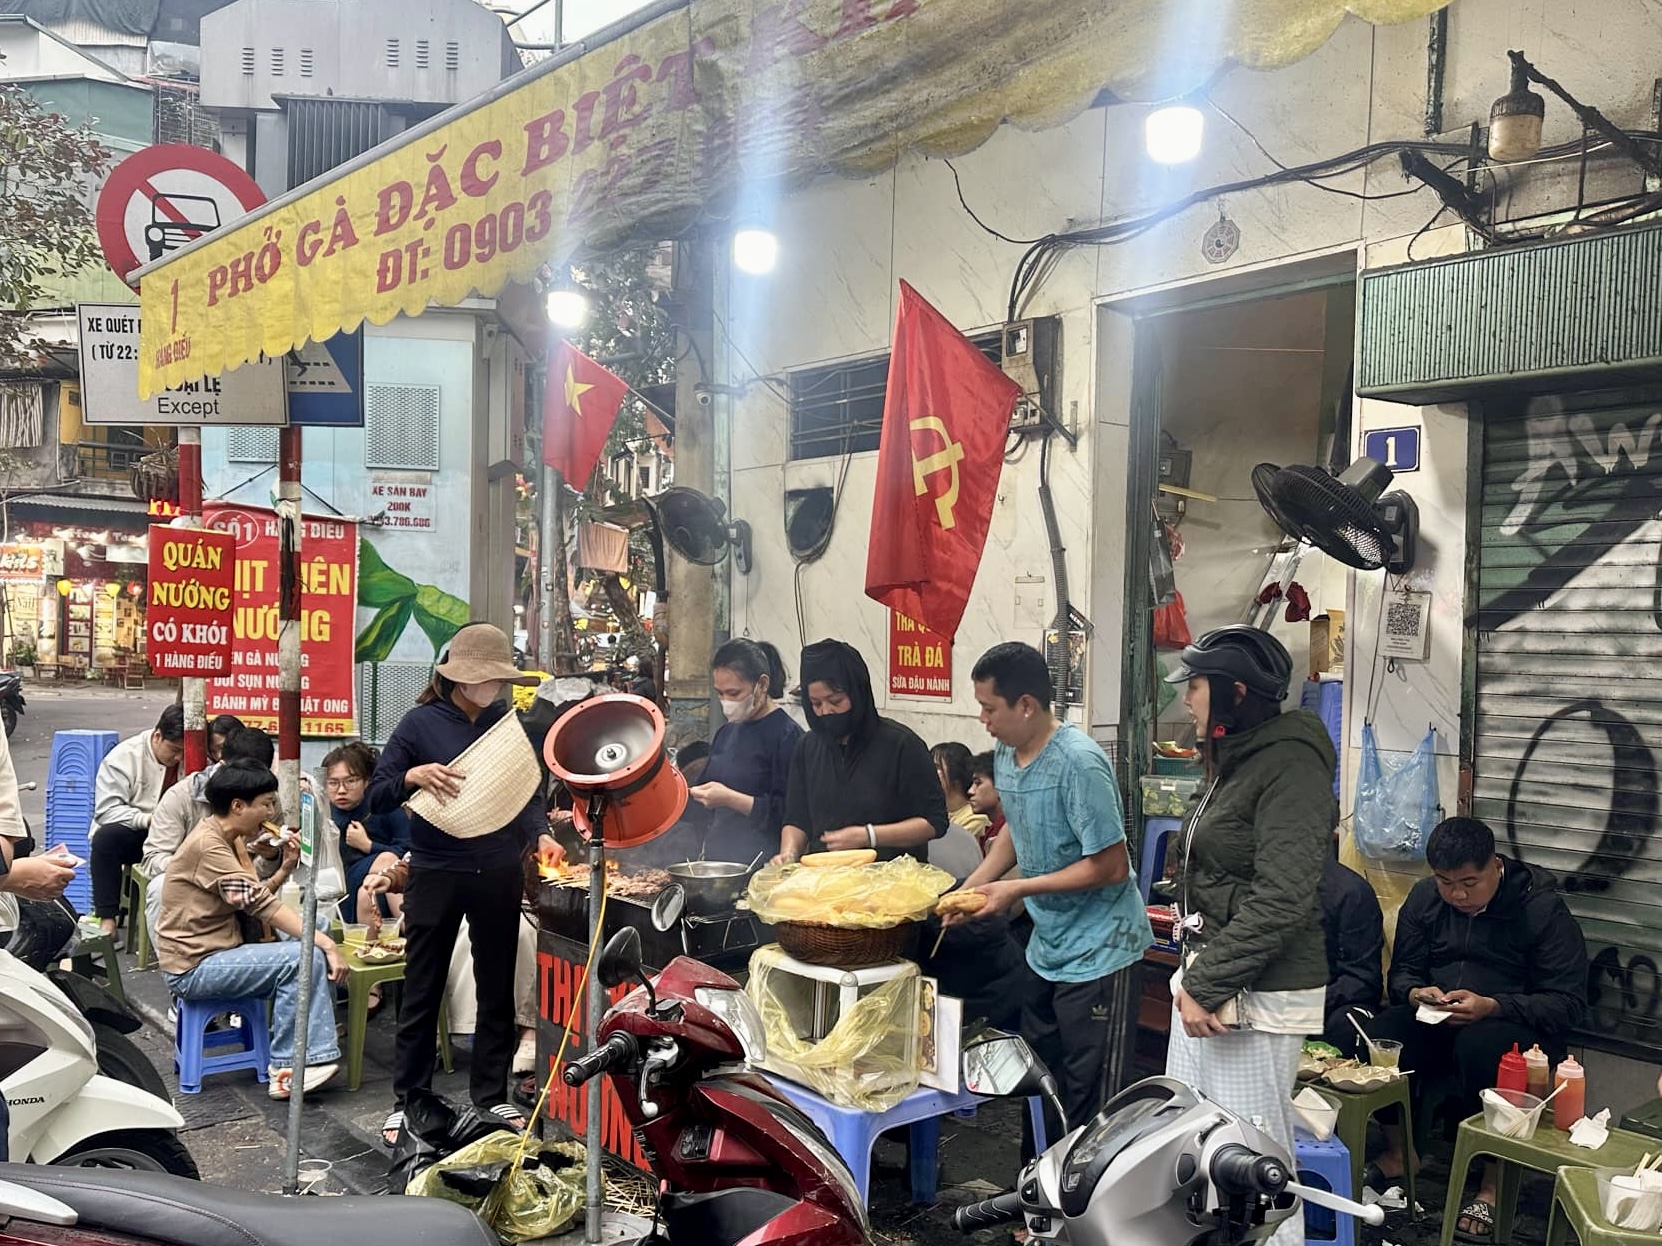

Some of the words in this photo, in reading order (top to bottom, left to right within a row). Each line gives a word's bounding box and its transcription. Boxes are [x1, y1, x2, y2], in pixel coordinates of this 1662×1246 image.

[207, 225, 282, 307] PHỞ
[296, 195, 360, 267] GÀ
[373, 139, 503, 237] ĐẶC
[376, 237, 431, 294] ĐT:
[443, 189, 553, 270] 0903
[170, 278, 179, 335] 1
[87, 317, 102, 333] XE
[106, 315, 135, 334] QUÉT
[157, 397, 220, 418] Except
[1384, 436, 1398, 467] 1
[163, 538, 223, 572] QUÁN
[151, 578, 231, 611] NƯỚNG
[152, 617, 177, 643] CÓ
[181, 620, 228, 645] KHÓI
[154, 653, 161, 668] 1
[164, 652, 195, 669] HÀNG
[197, 651, 223, 670] ĐIẾU
[246, 649, 262, 666] GÀ
[897, 641, 922, 667] TRÀ
[925, 641, 944, 668] ĐÁ
[237, 673, 263, 691] SỤN
[323, 698, 349, 713] ONG
